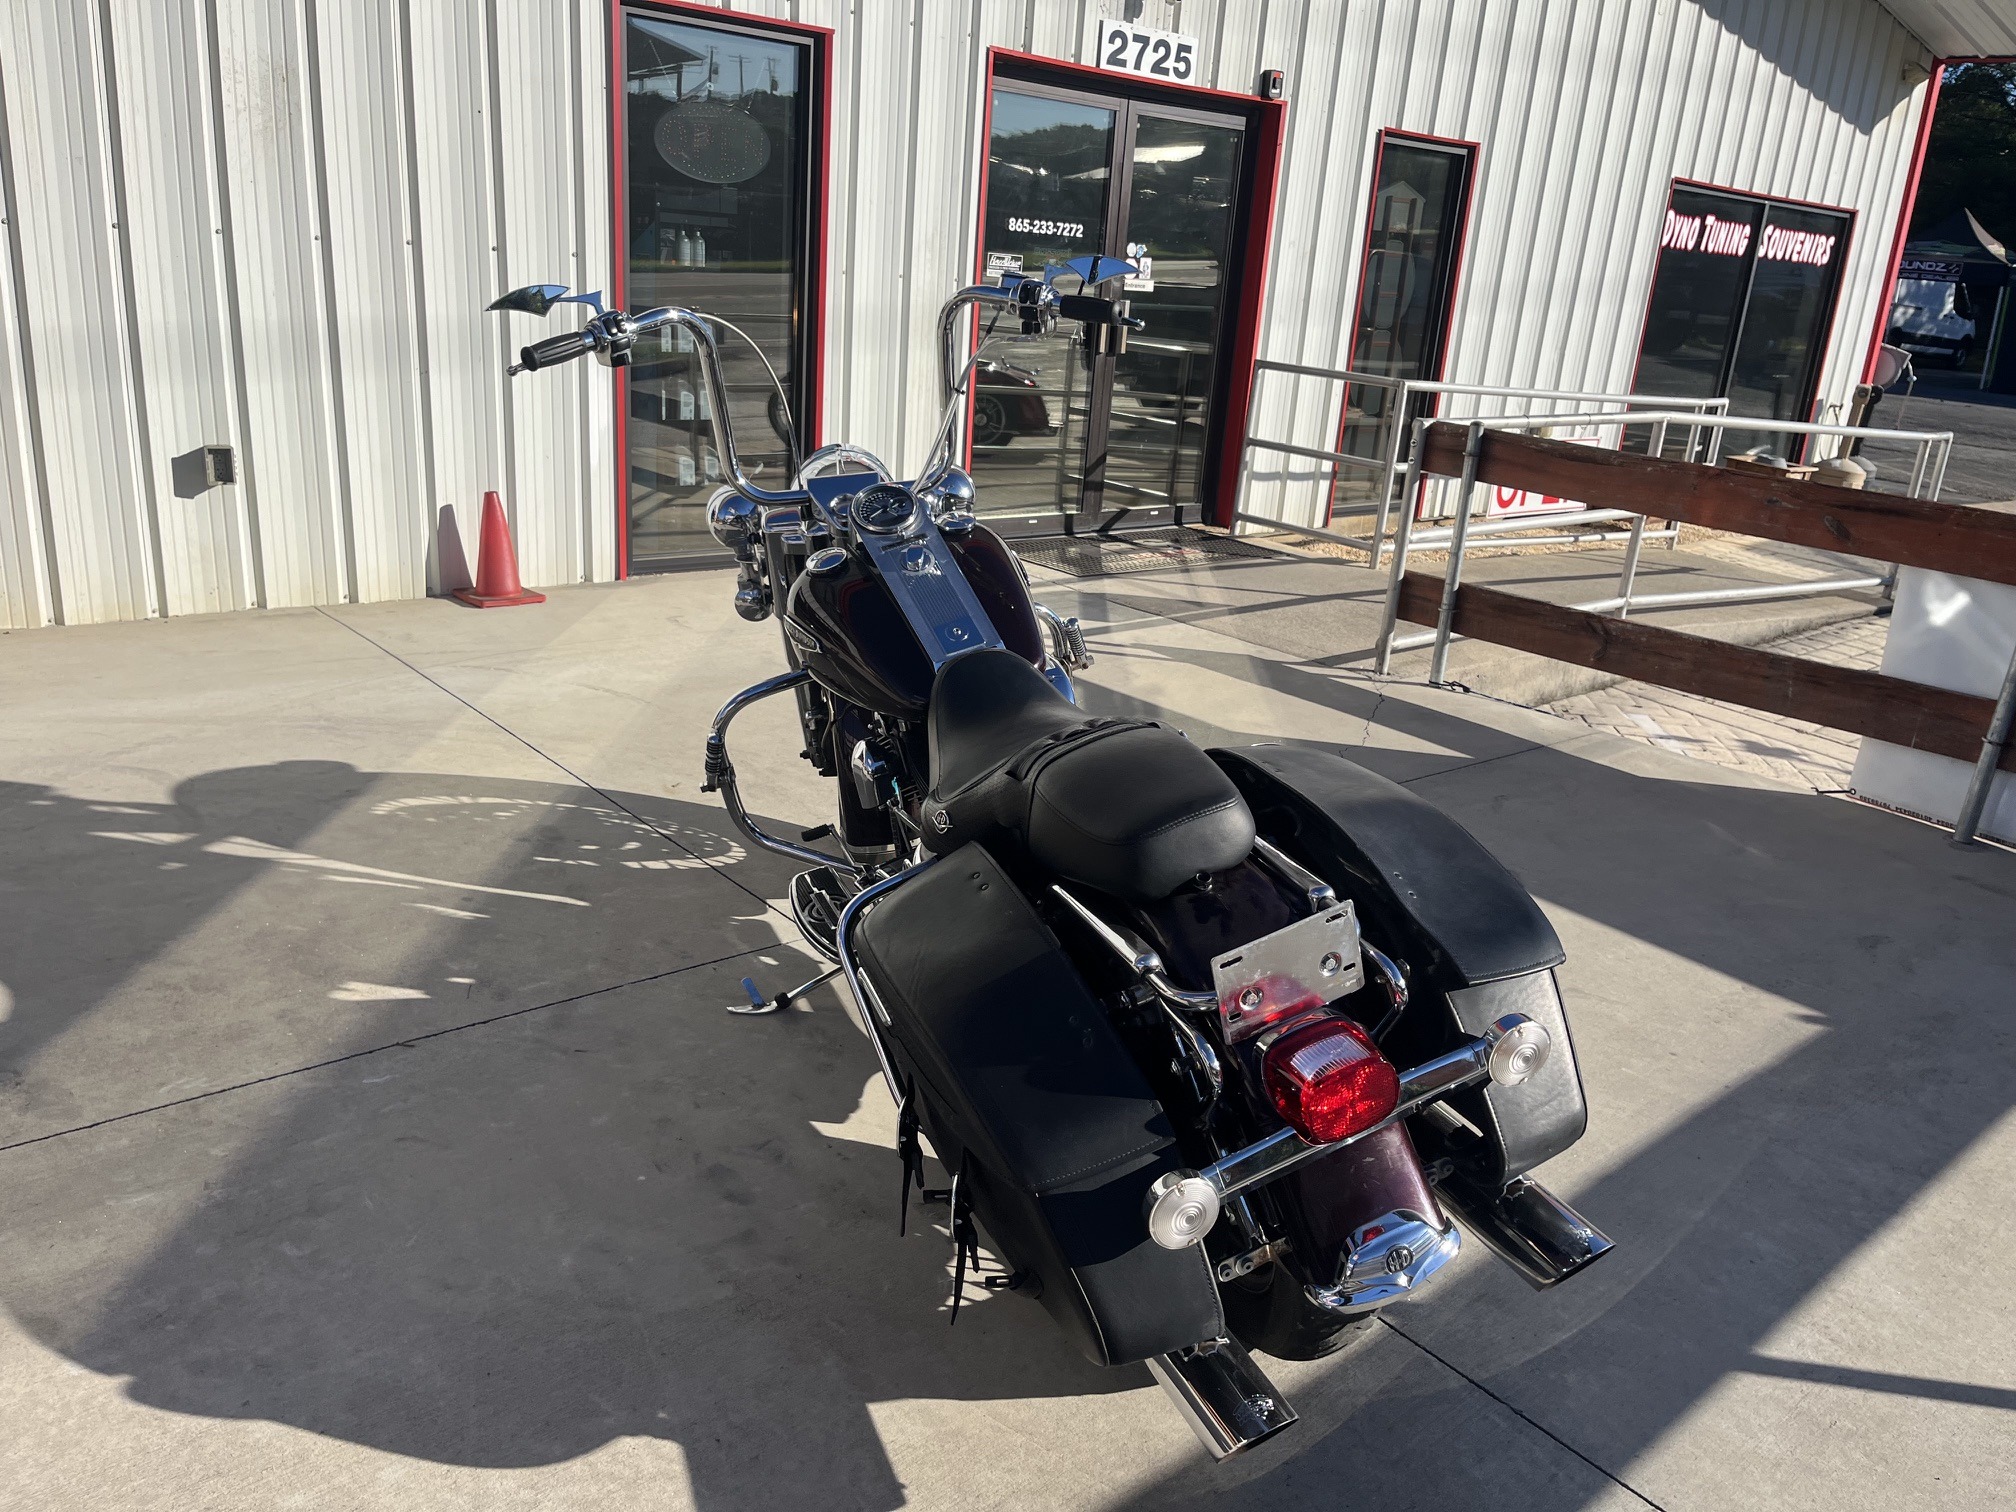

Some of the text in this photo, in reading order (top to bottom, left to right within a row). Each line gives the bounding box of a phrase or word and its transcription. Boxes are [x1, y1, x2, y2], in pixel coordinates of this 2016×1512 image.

[1106, 29, 1193, 80] 2725
[1008, 217, 1084, 238] 865-233-7272
[1661, 208, 1751, 258] DYNO TUNING
[1758, 224, 1836, 267] SOUVENIRS
